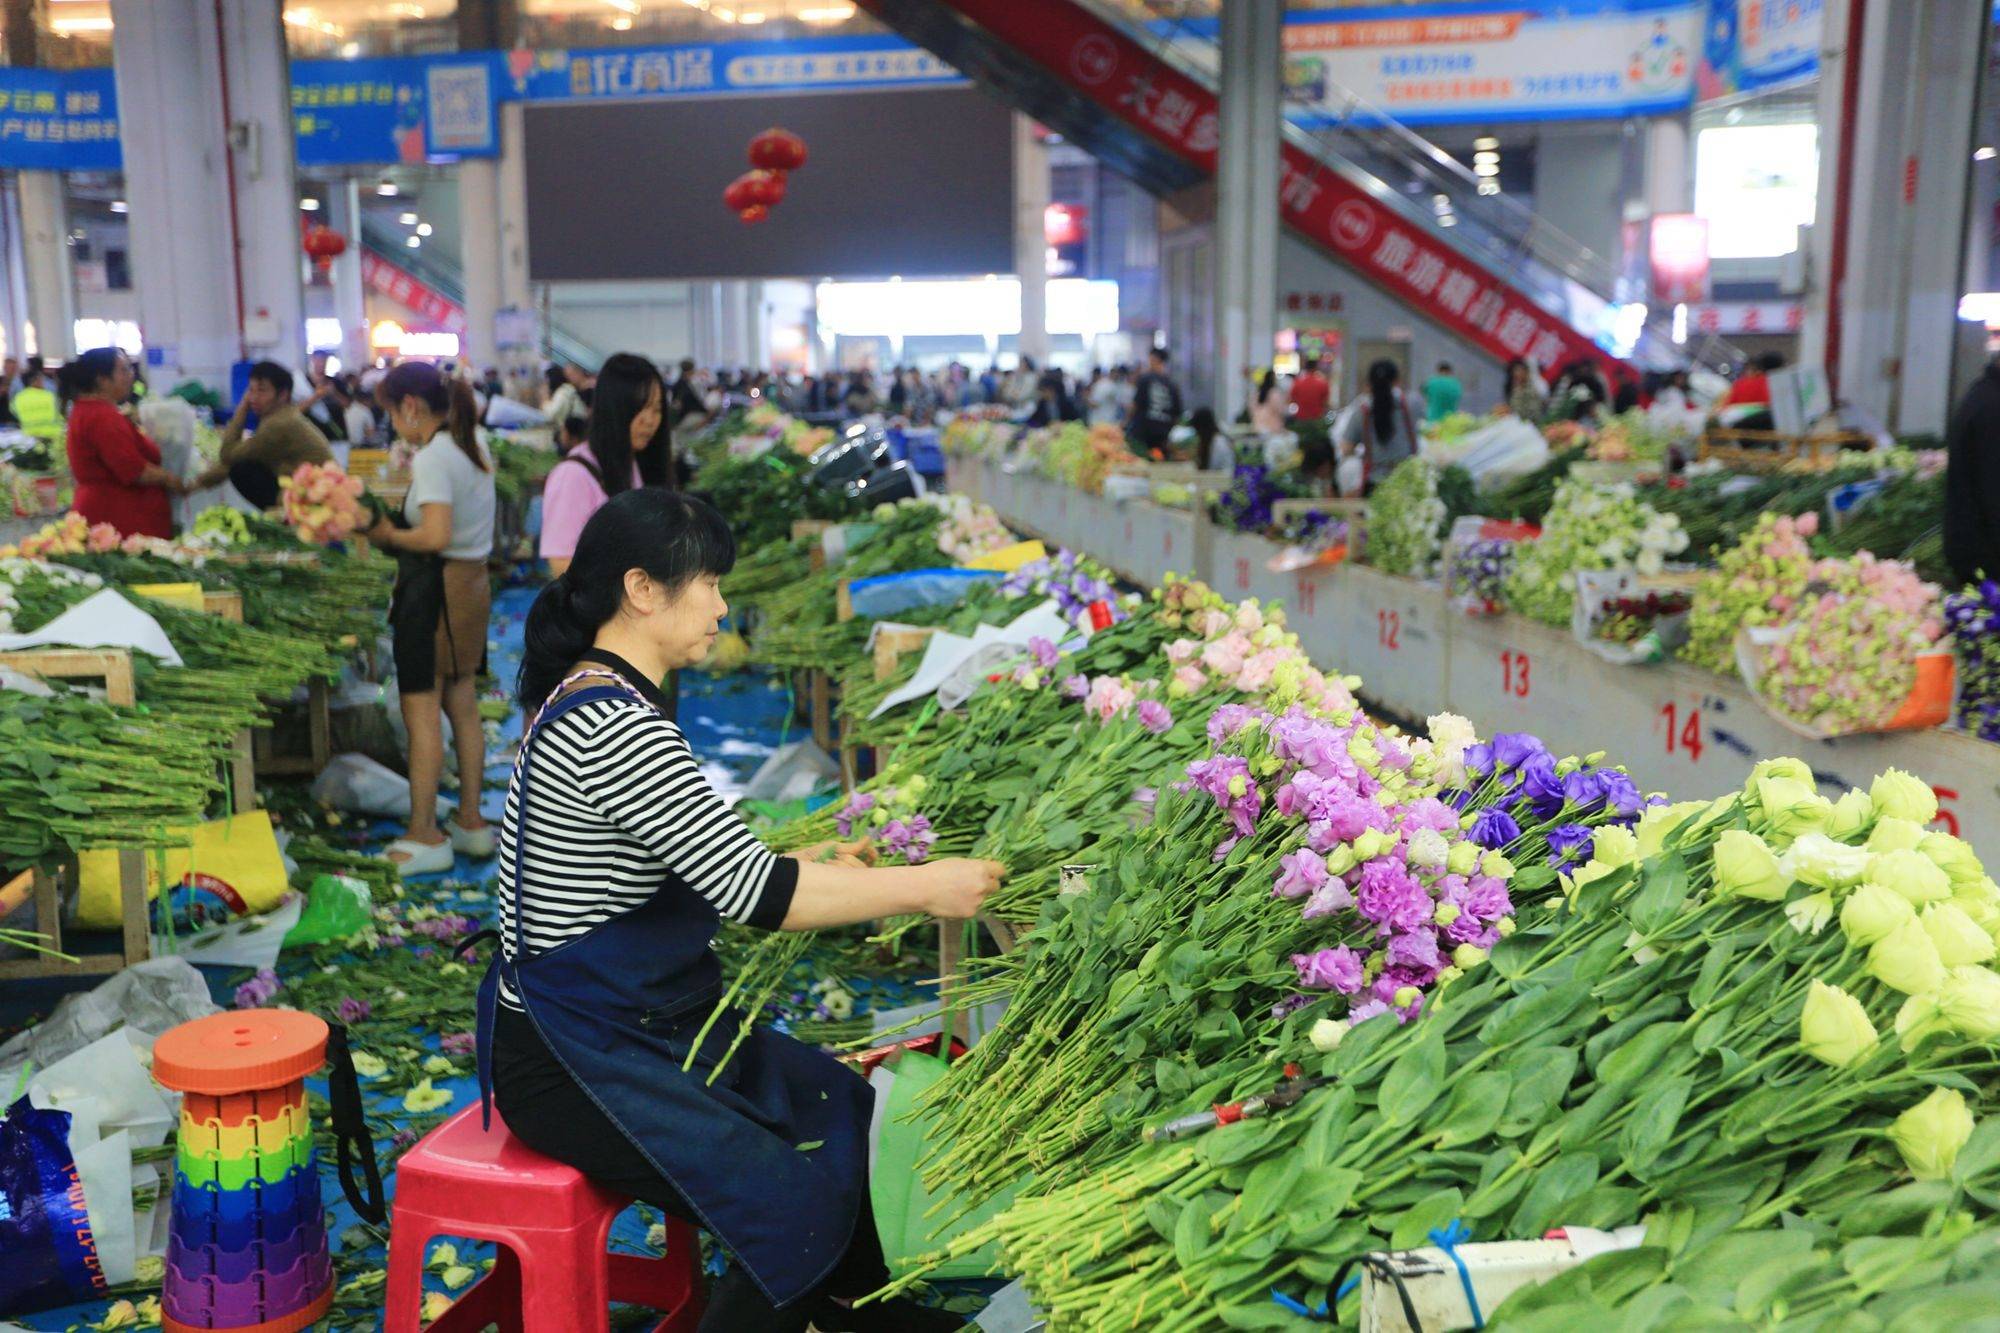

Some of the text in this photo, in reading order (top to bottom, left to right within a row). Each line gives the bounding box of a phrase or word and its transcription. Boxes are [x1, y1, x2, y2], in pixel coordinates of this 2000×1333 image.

[1372, 230, 1567, 369] 旅游精品超市
[1297, 579, 1316, 617] 11
[1378, 608, 1401, 650] 12
[1500, 651, 1530, 698] 13
[1661, 700, 1704, 762] 14
